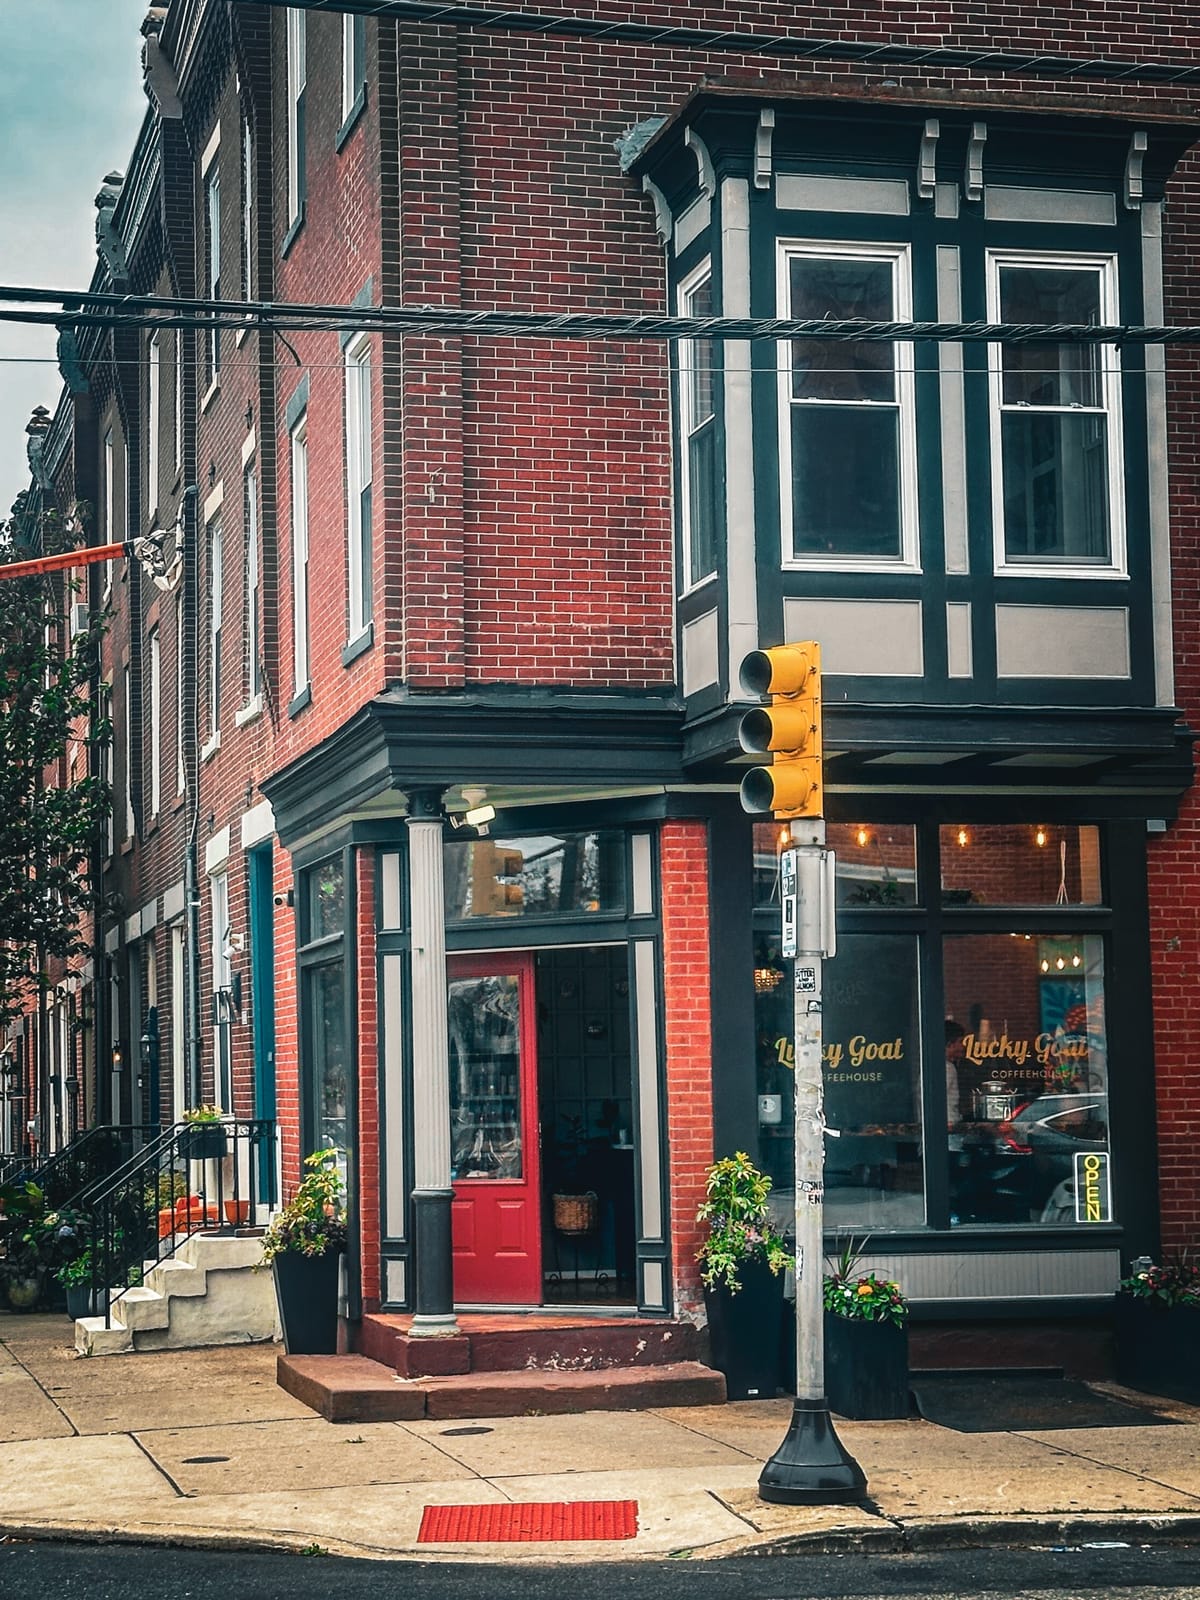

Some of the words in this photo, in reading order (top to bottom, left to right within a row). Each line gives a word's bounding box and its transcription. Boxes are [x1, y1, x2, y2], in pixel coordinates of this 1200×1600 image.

[774, 1037, 844, 1069] Luy
[848, 1035, 904, 1067] Goat
[962, 1033, 1029, 1065] Lucky
[822, 1072, 883, 1082] FEEHOUSE
[1084, 1155, 1101, 1221] OPEN
